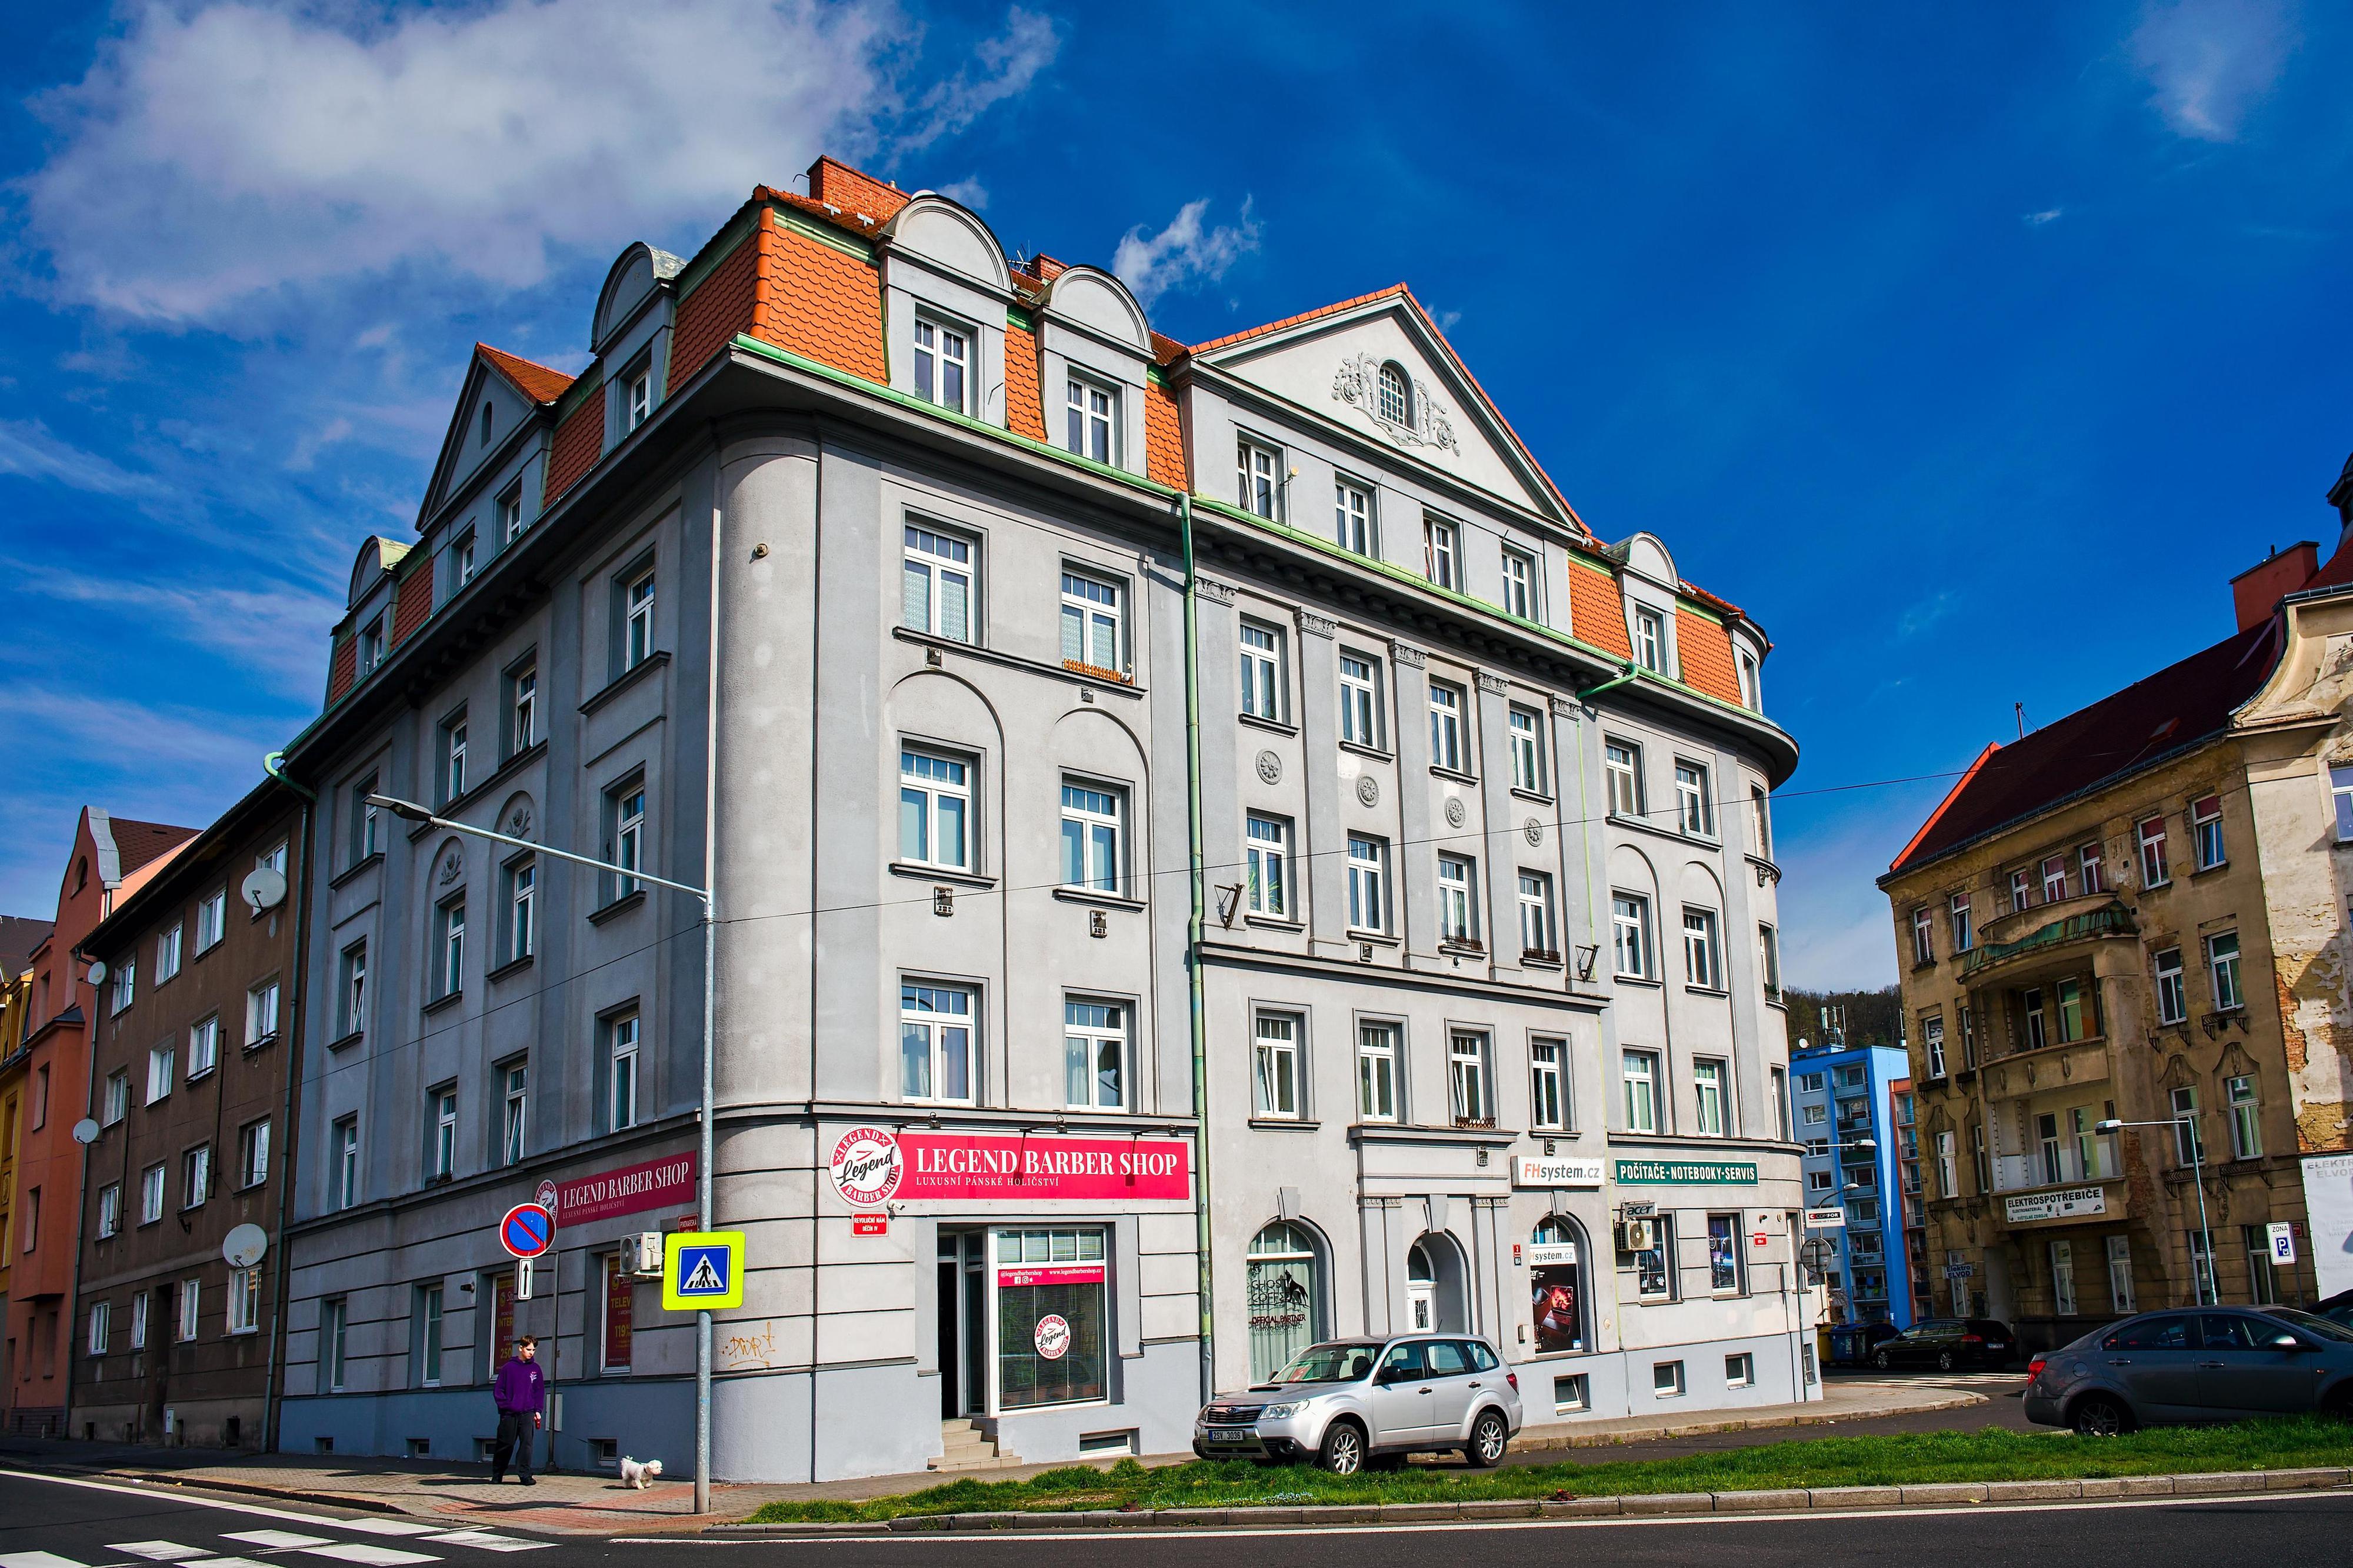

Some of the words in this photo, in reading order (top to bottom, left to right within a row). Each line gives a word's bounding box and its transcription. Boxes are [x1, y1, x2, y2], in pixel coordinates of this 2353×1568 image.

[839, 1129, 879, 1153] LEGEND
[836, 1147, 894, 1186] Legend
[916, 1148, 1018, 1173] LEGEND
[1024, 1150, 1115, 1175] BARBER
[1120, 1152, 1177, 1176] SHOP
[916, 1176, 961, 1186] LUXUSNÍ
[965, 1176, 1002, 1186] PÁNSKÉ
[1008, 1176, 1059, 1186] HOLIČSTVÍ
[1525, 1163, 1599, 1182] FHsystem.cz
[564, 1182, 606, 1209] LEGEND
[608, 1170, 652, 1199] BARBER
[655, 1162, 689, 1189] SHOP
[845, 1186, 882, 1202] BARBER
[881, 1168, 899, 1195] SHOP
[2008, 1189, 2100, 1208] ELEKTROSPOTŘEBIČE
[563, 1208, 581, 1219] LUXUSNÍ
[1627, 1204, 1654, 1216] acer
[1251, 1279, 1287, 1290] GHOST
[1037, 1326, 1066, 1348] Legend
